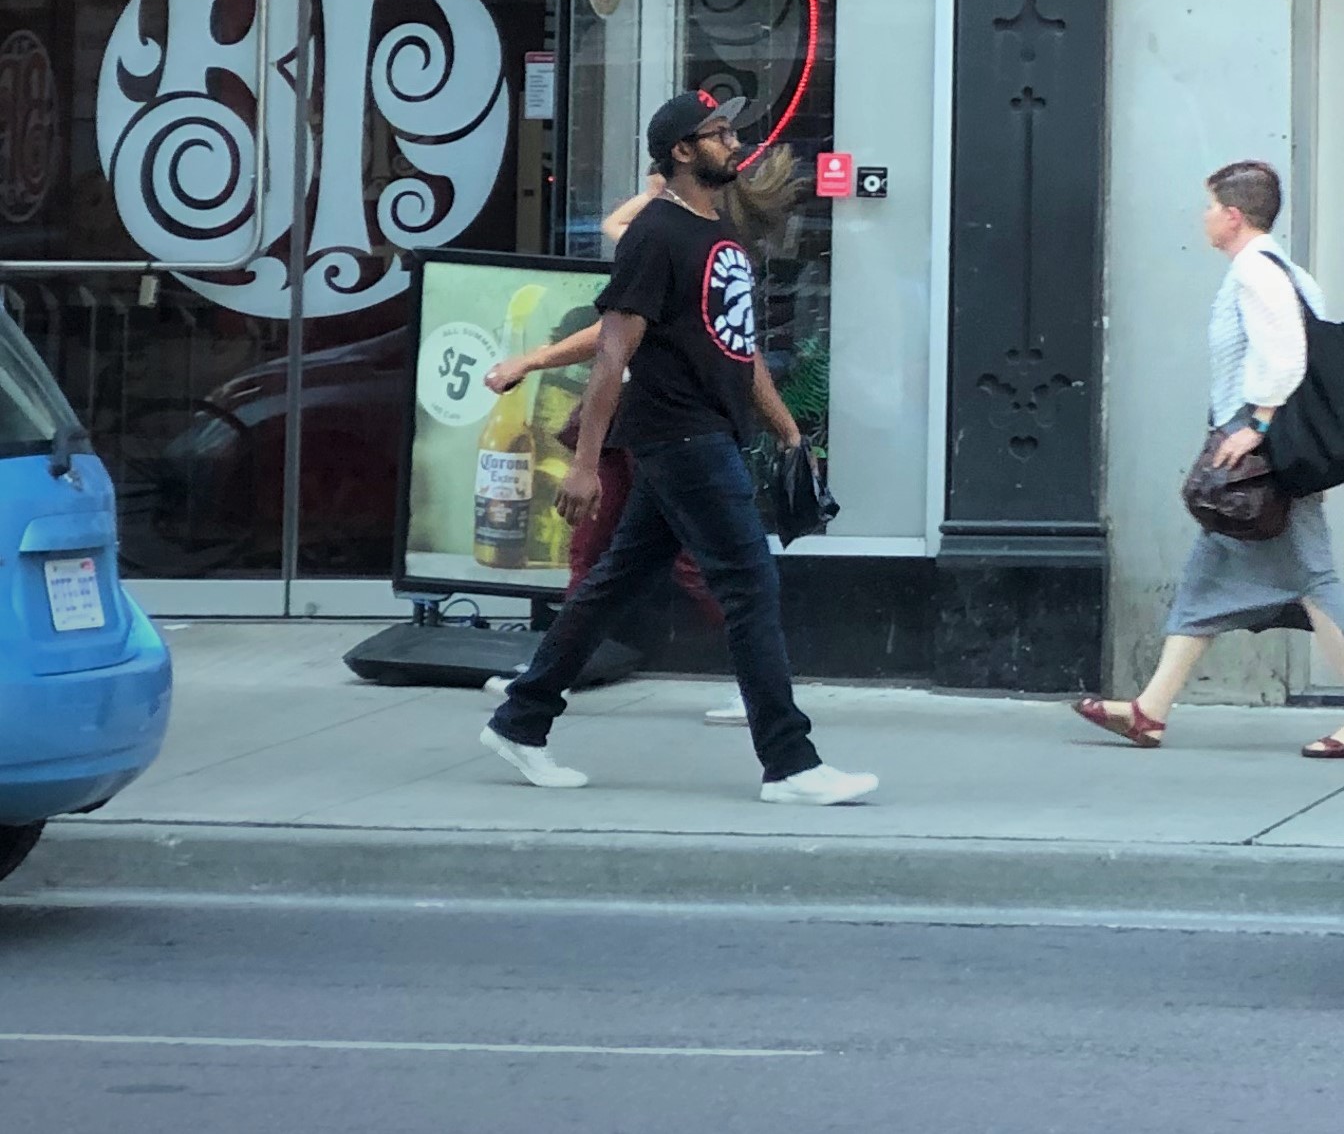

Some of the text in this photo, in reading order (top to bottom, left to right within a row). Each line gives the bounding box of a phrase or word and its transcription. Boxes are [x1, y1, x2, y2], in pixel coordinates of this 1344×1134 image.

[438, 346, 478, 401] $5
[481, 453, 528, 470] Corona
[490, 470, 520, 484] Extra
